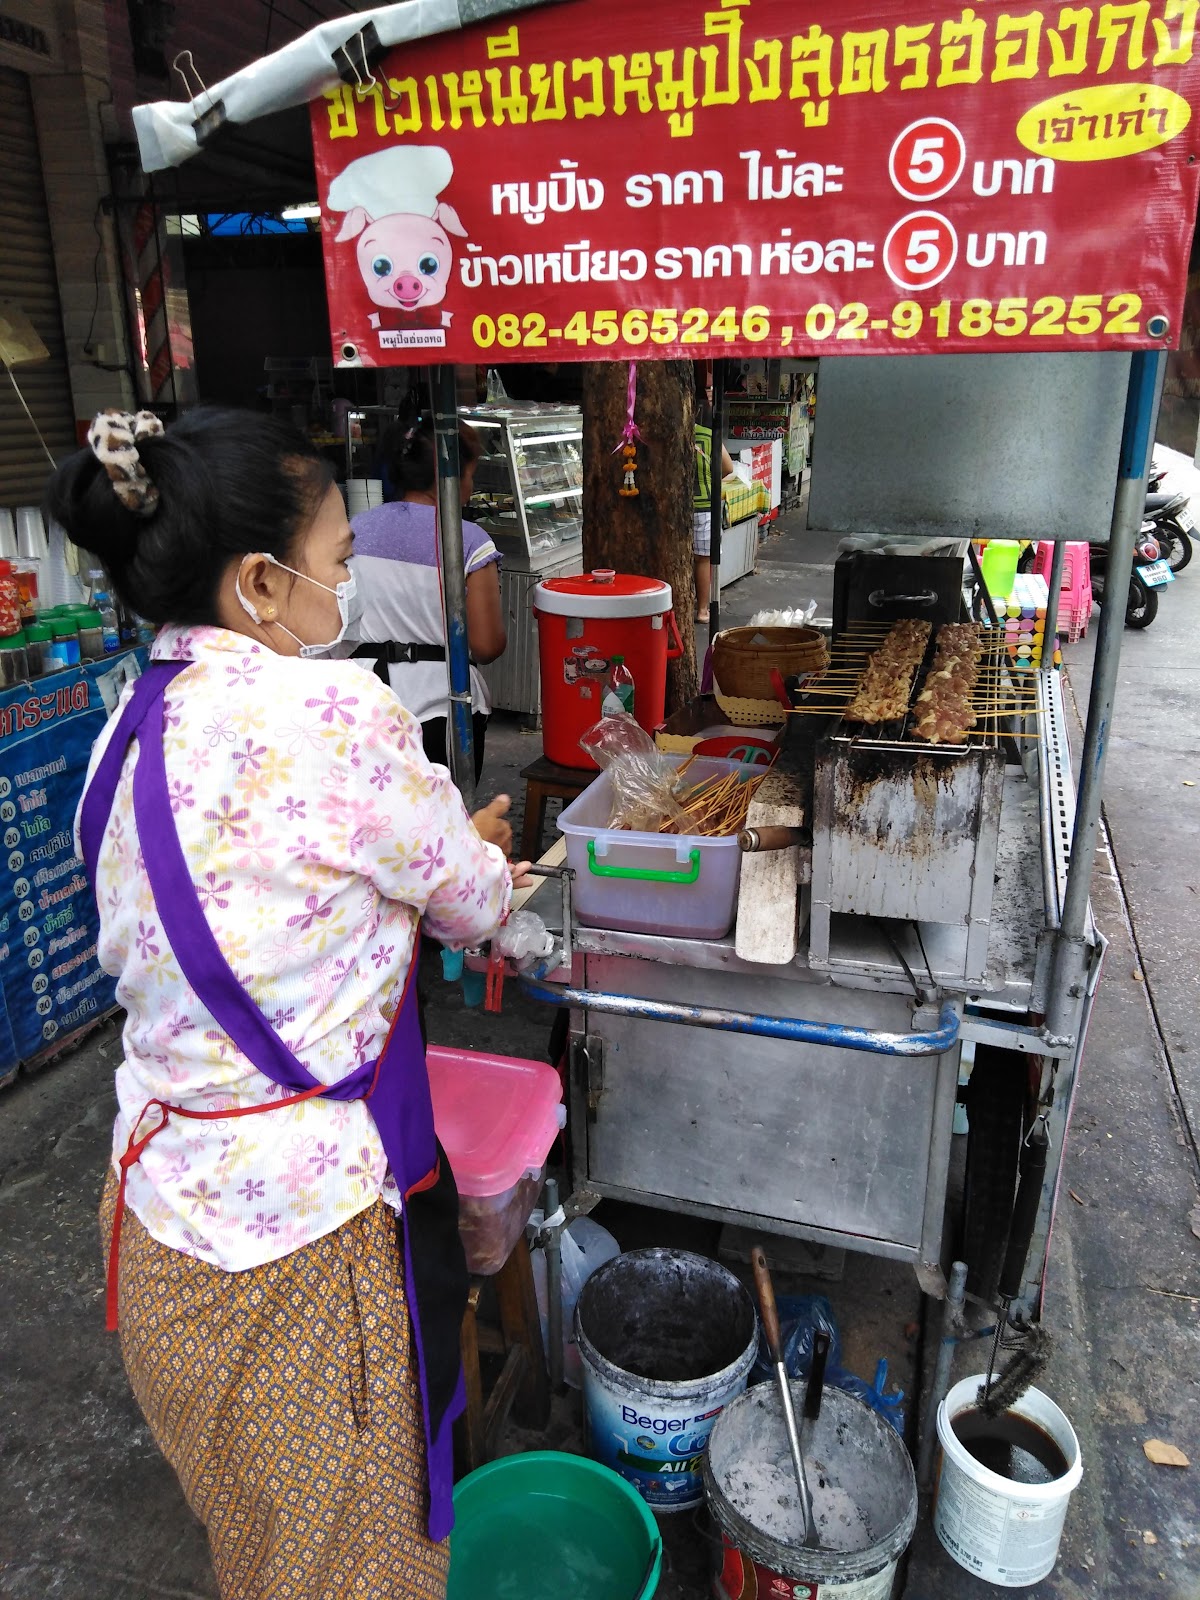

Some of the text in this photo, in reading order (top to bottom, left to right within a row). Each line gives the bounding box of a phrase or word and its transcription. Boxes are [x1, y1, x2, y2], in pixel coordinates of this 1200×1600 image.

[1037, 93, 1169, 145] เจ้าเก่า
[492, 136, 1056, 225] หมูปิ้ง ราคา ไม้ละ 5 บาท
[459, 227, 1047, 287] ข้าวเหนียว ราคา ห่อละ 5 บาท
[472, 305, 770, 348] 082-4565246
[805, 293, 1143, 341] 02-9185252
[622, 1404, 692, 1435] Beger
[658, 1460, 688, 1473] All
